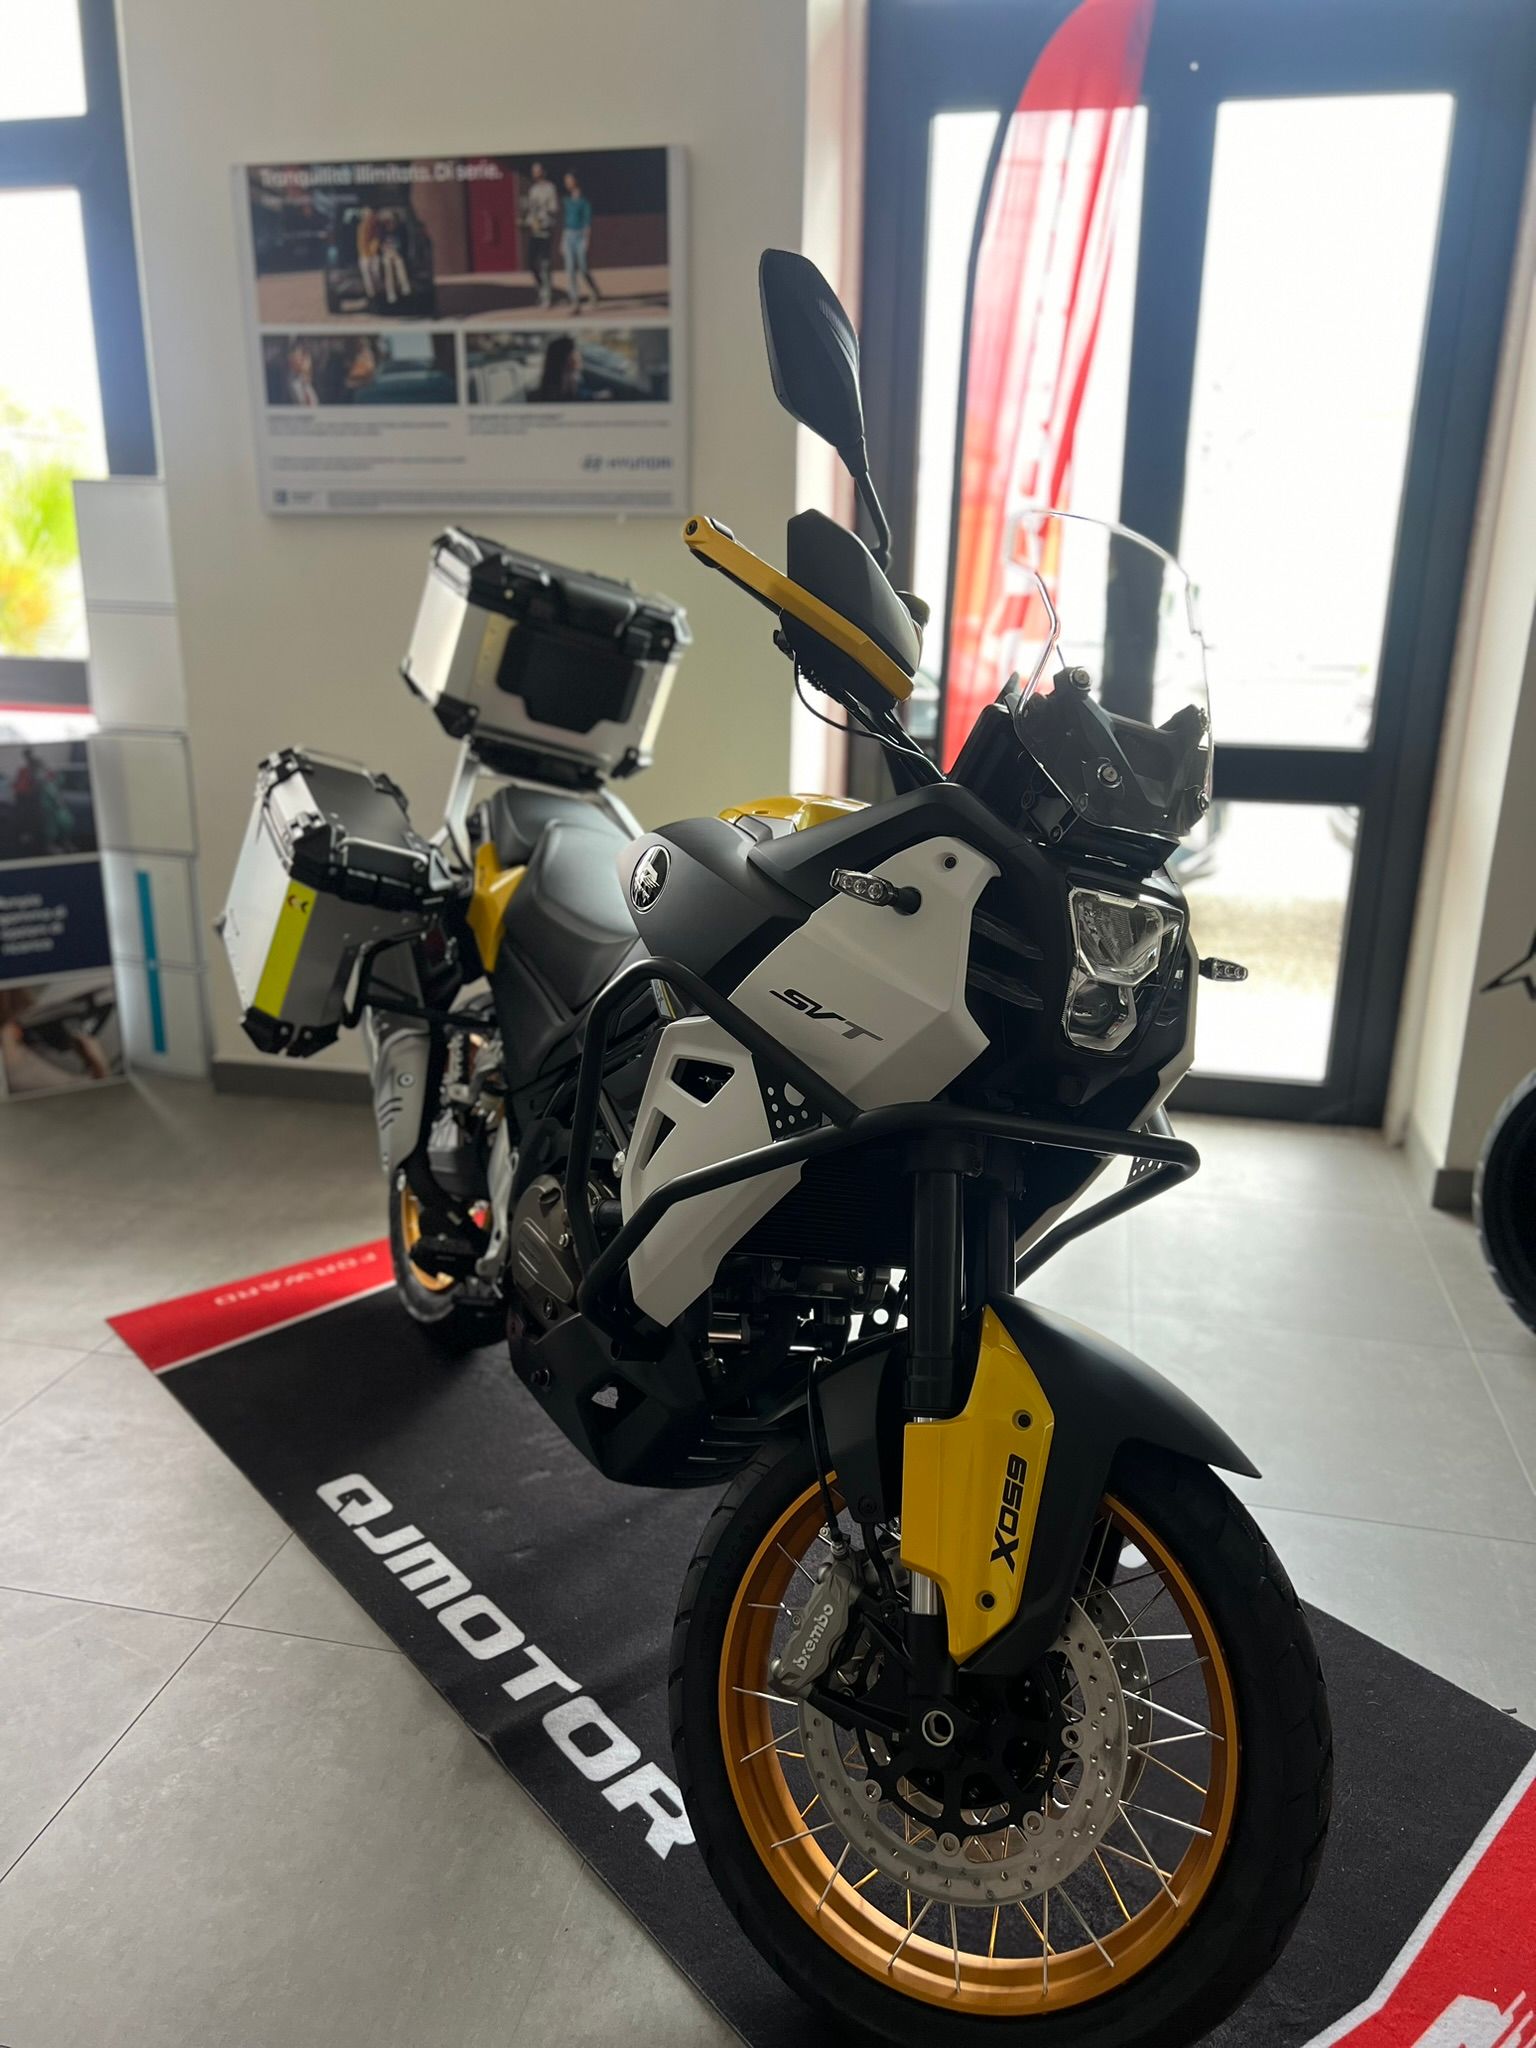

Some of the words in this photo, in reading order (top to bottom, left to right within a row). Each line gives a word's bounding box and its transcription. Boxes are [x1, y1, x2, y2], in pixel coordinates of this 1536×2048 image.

[769, 988, 884, 1041] SVT
[990, 1453, 1028, 1575] 650X
[315, 1473, 697, 1861] QJMOTOR
[793, 1604, 833, 1670] brembo
